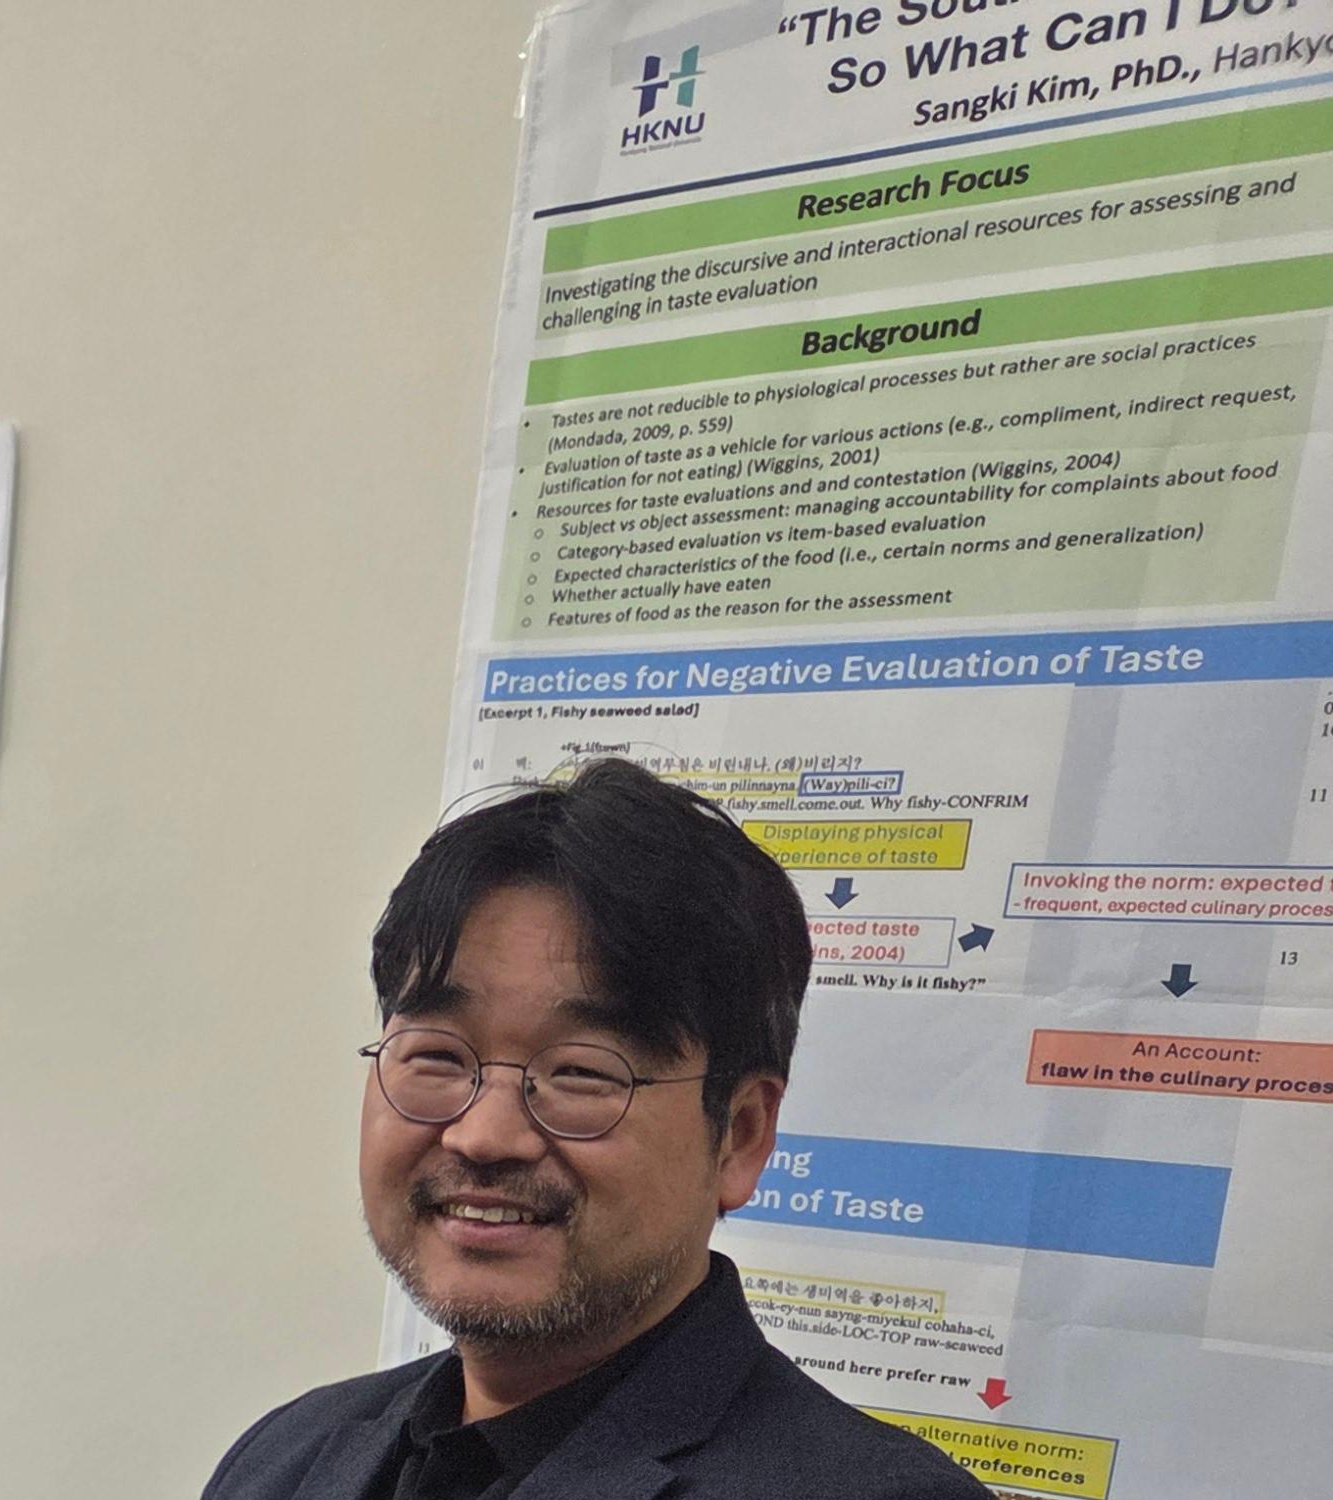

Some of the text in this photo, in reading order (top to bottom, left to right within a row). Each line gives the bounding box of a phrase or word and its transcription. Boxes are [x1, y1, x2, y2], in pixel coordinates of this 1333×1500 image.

[827, 56, 887, 95] So
[905, 24, 1030, 79] What
[1045, 7, 1148, 51] Can
[913, 83, 1018, 126] Sangki
[1026, 74, 1100, 107] Kim,
[1111, 54, 1201, 91] PhD.,
[620, 111, 707, 148] HKNU
[797, 163, 1030, 220] Research Focus
[545, 172, 1298, 304] Investigating the discursive and interactional resources for assessing and
[542, 274, 818, 331] challenging in taste evaluation
[801, 308, 982, 357] Background
[551, 334, 1257, 428] Tastes reducible physiological processes but rather are social practices
[544, 384, 1297, 476] Evaluation taste vehicle various actions compliment, indirect request,
[547, 415, 734, 454] (Mondada, 2009, 559)
[686, 460, 743, 482] eating)
[746, 454, 825, 478] (Wiggins,
[830, 447, 881, 468] 2001)
[536, 450, 1121, 519] Resources taste evaluations contestation (Wiggins, 2004)
[559, 466, 1226, 539] Subject object assessment: managing accountability complaints about
[554, 521, 1205, 586] Expected characteristics certain norms generalization)
[556, 511, 986, 562] Category-based evaluation item-based evaluation
[552, 575, 772, 603] Whether actually have eaten
[548, 588, 953, 627] Features reason assessment
[489, 643, 1206, 695] Practices for Negative Evaluation of Taste
[551, 705, 588, 720] Fishy
[590, 704, 652, 718] seaweed
[763, 823, 944, 845] Displaying physical
[890, 850, 939, 865] taste
[1023, 872, 1324, 895] Invoking the norm: expected
[1023, 896, 1266, 918] frequent, expected culinary
[871, 922, 920, 937] taste
[1280, 951, 1299, 966] 13
[815, 974, 859, 988] smell.
[863, 973, 897, 991] Why
[1132, 1041, 1263, 1065] An Account:
[1041, 1062, 1251, 1094] flaw in the culinary
[789, 1188, 825, 1214] of
[830, 1189, 926, 1224] Taste
[913, 1335, 1005, 1358] raw-seaweed
[794, 1354, 972, 1388] around here prefer raw
[917, 1426, 1084, 1461] alternative norm:
[959, 1455, 1086, 1487] preferences
